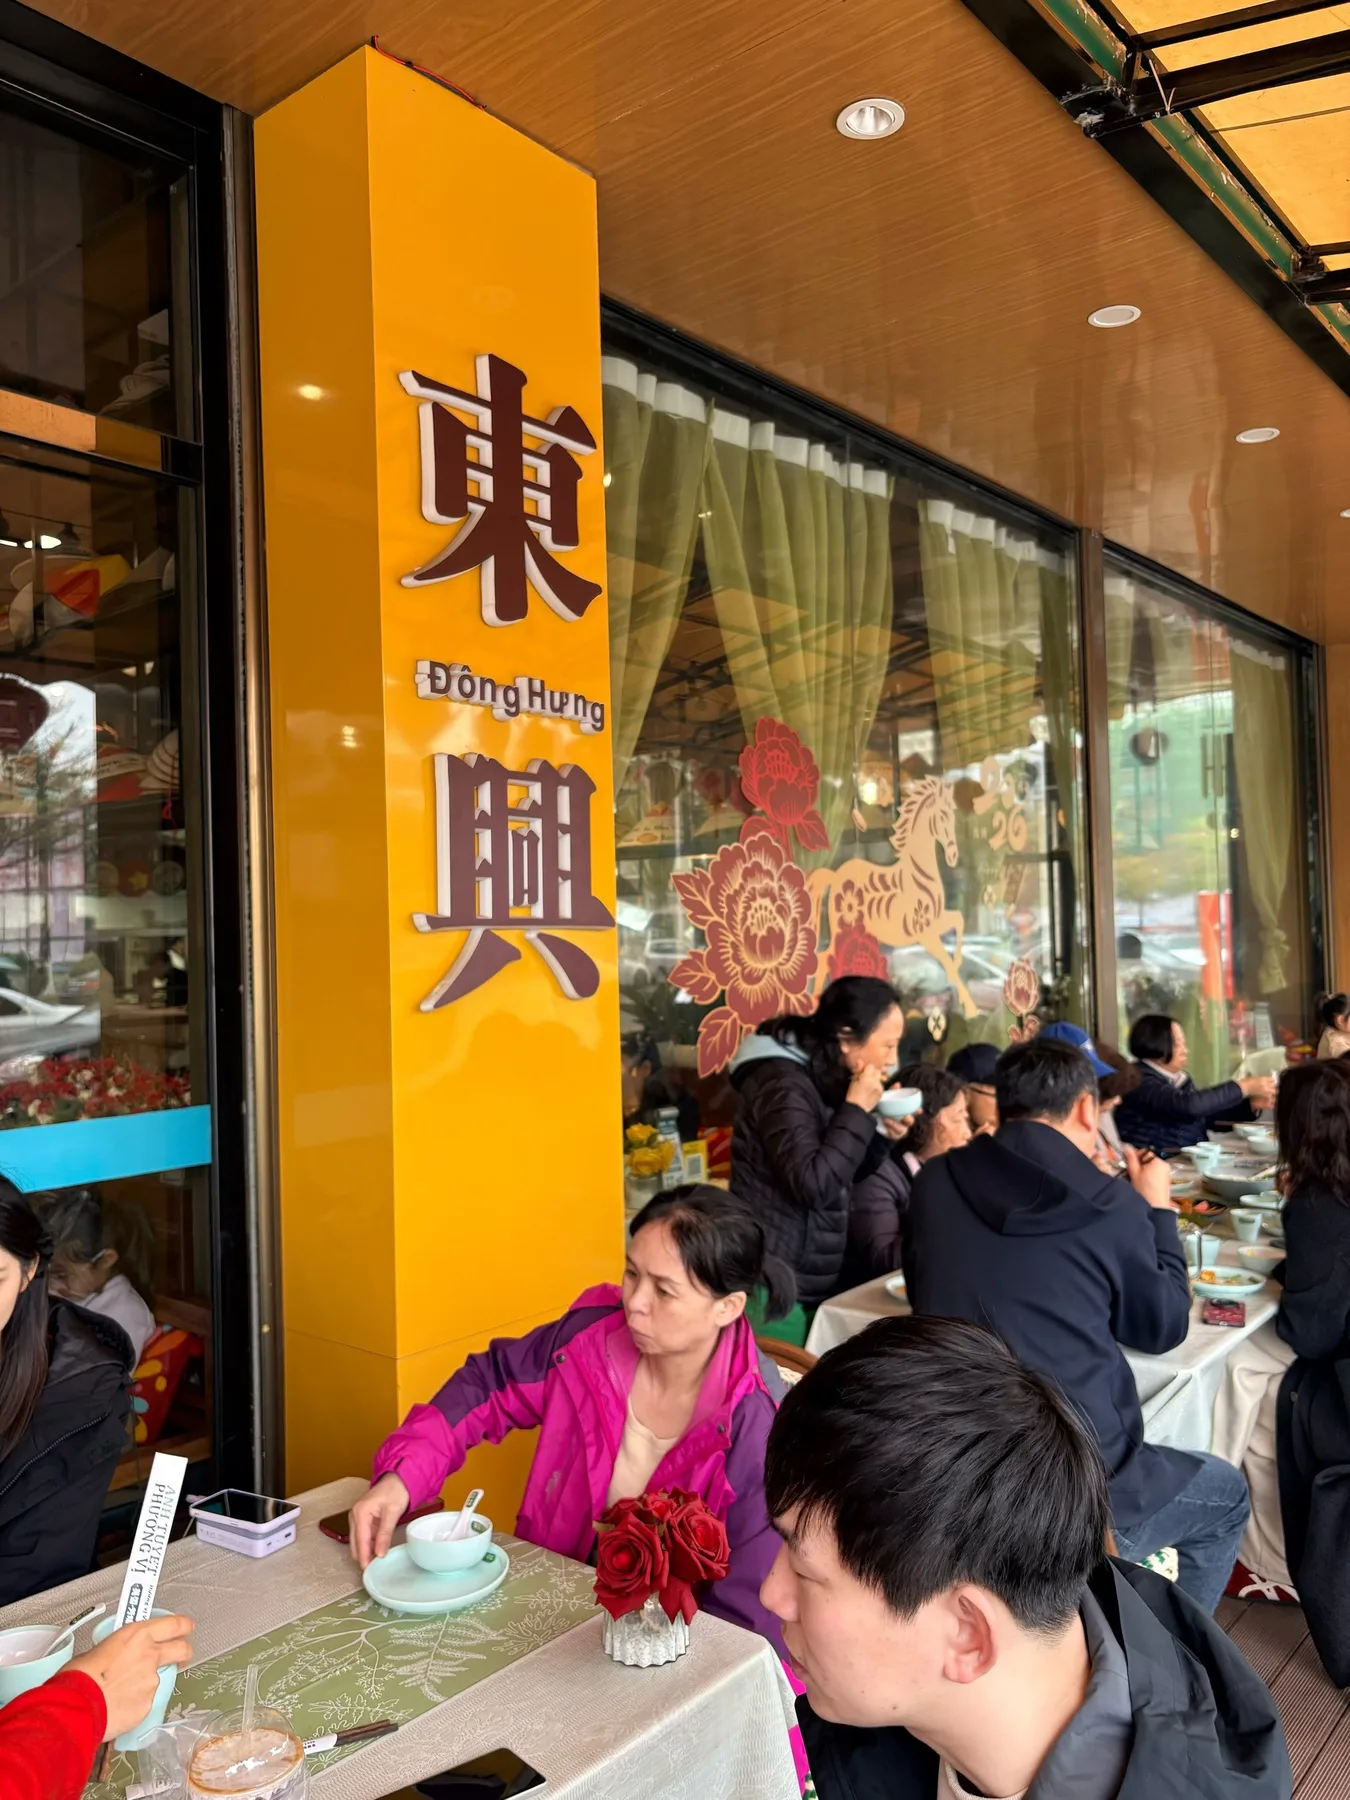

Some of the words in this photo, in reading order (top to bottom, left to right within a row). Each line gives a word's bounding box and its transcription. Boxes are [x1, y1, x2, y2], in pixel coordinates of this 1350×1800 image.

[398, 353, 603, 627] 東
[418, 660, 520, 720] Đông
[520, 676, 605, 733] Hưng
[412, 751, 616, 1012] 興
[139, 1483, 166, 1553] PHƯƠNG
[160, 1484, 176, 1520] ANH
[131, 1558, 148, 1574] VỊ
